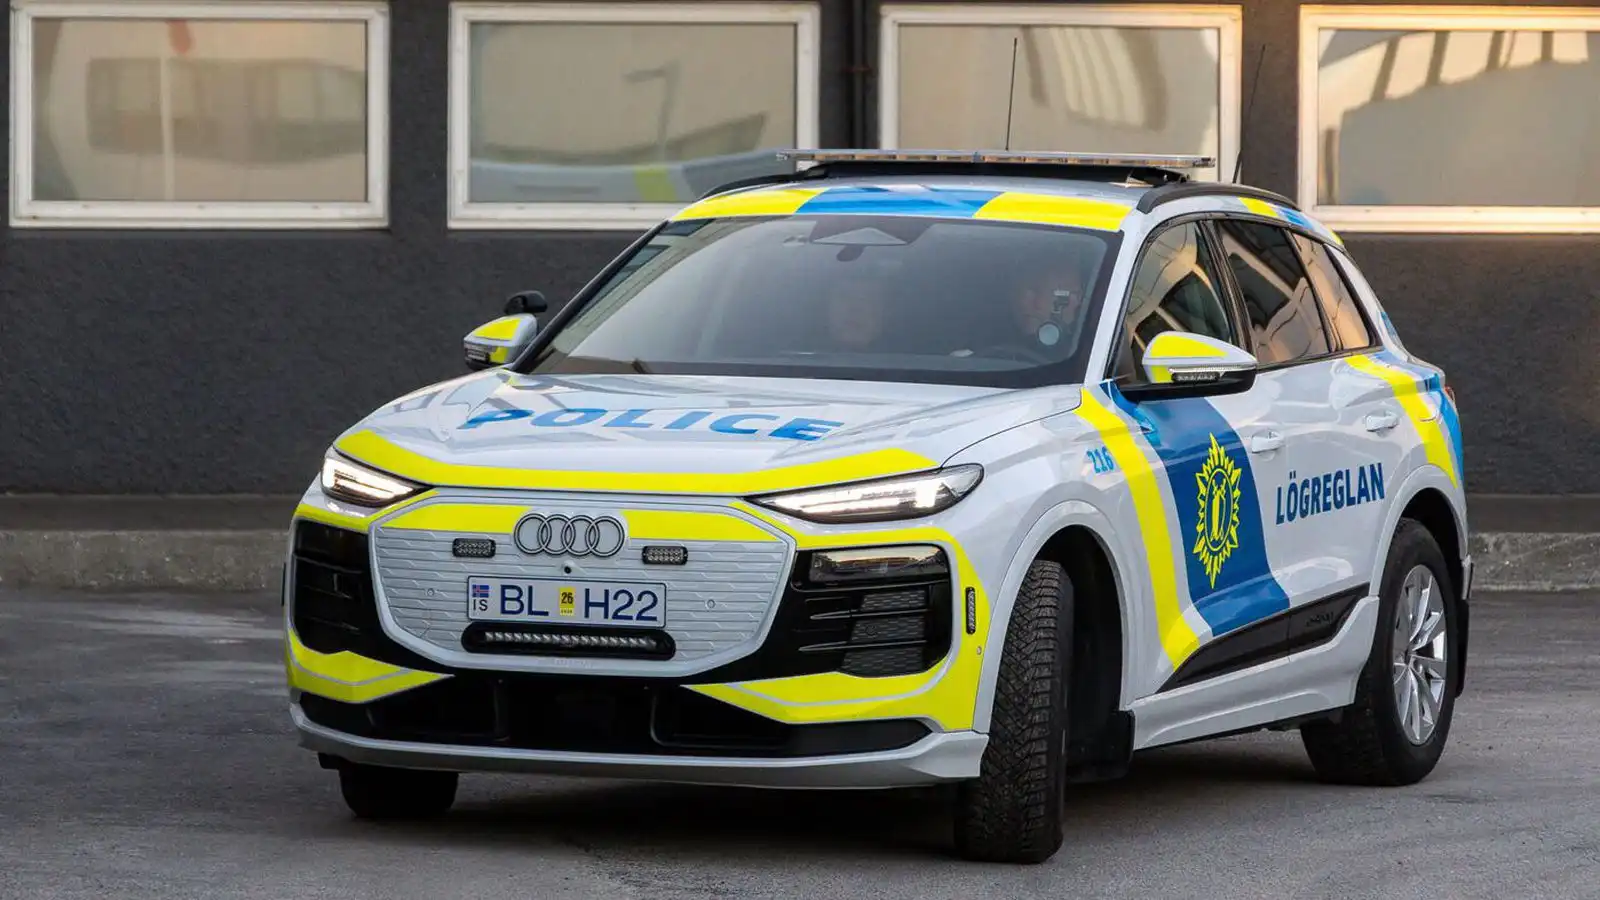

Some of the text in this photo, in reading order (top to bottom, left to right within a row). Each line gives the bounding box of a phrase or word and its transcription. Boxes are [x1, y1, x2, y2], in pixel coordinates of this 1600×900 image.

[456, 407, 845, 441] POLICE
[1086, 446, 1115, 473] 216
[1275, 462, 1385, 525] LÖGREGLAN
[473, 598, 488, 611] IS
[500, 584, 658, 622] BL H22
[561, 591, 574, 605] 26
